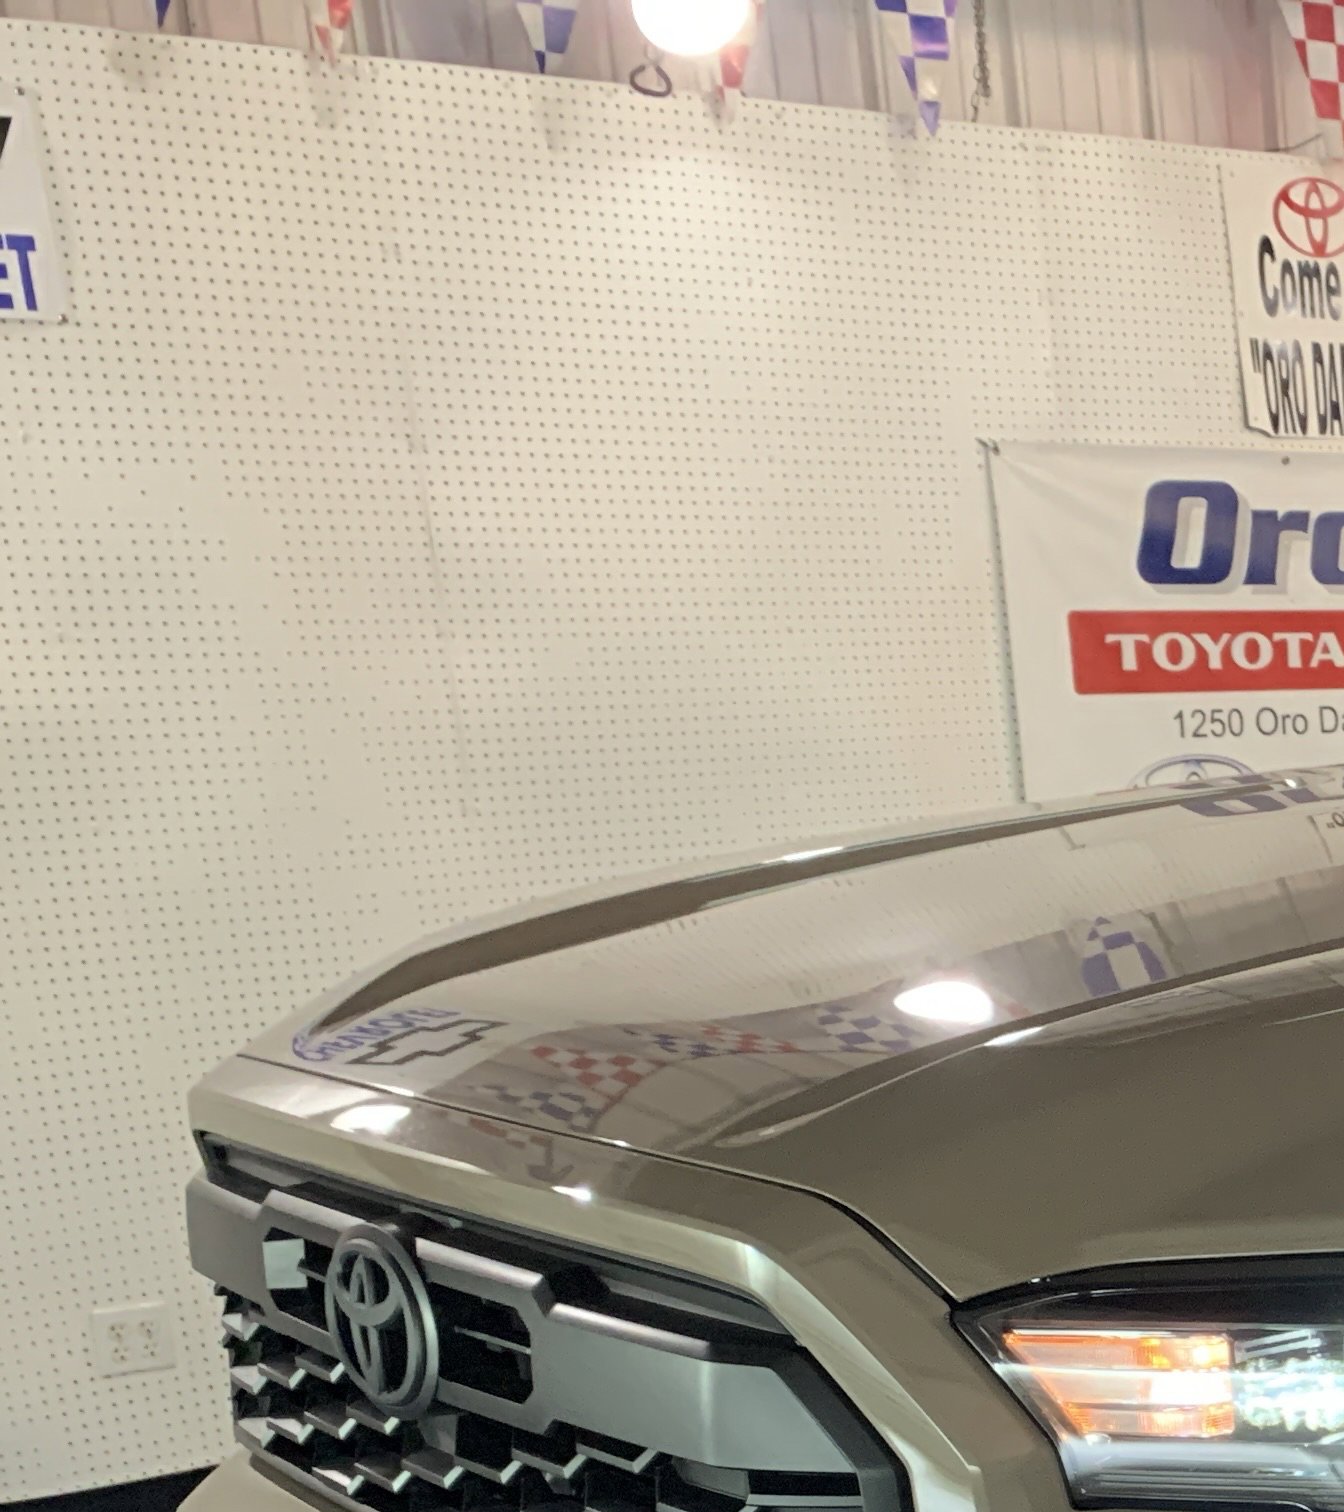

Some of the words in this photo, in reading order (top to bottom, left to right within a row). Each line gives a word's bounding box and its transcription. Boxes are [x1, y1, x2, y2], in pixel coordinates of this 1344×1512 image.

[1259, 235, 1342, 321] Come
[1250, 338, 1308, 436] "ORO
[1173, 708, 1245, 739] 1250
[1260, 706, 1308, 738] Oro
